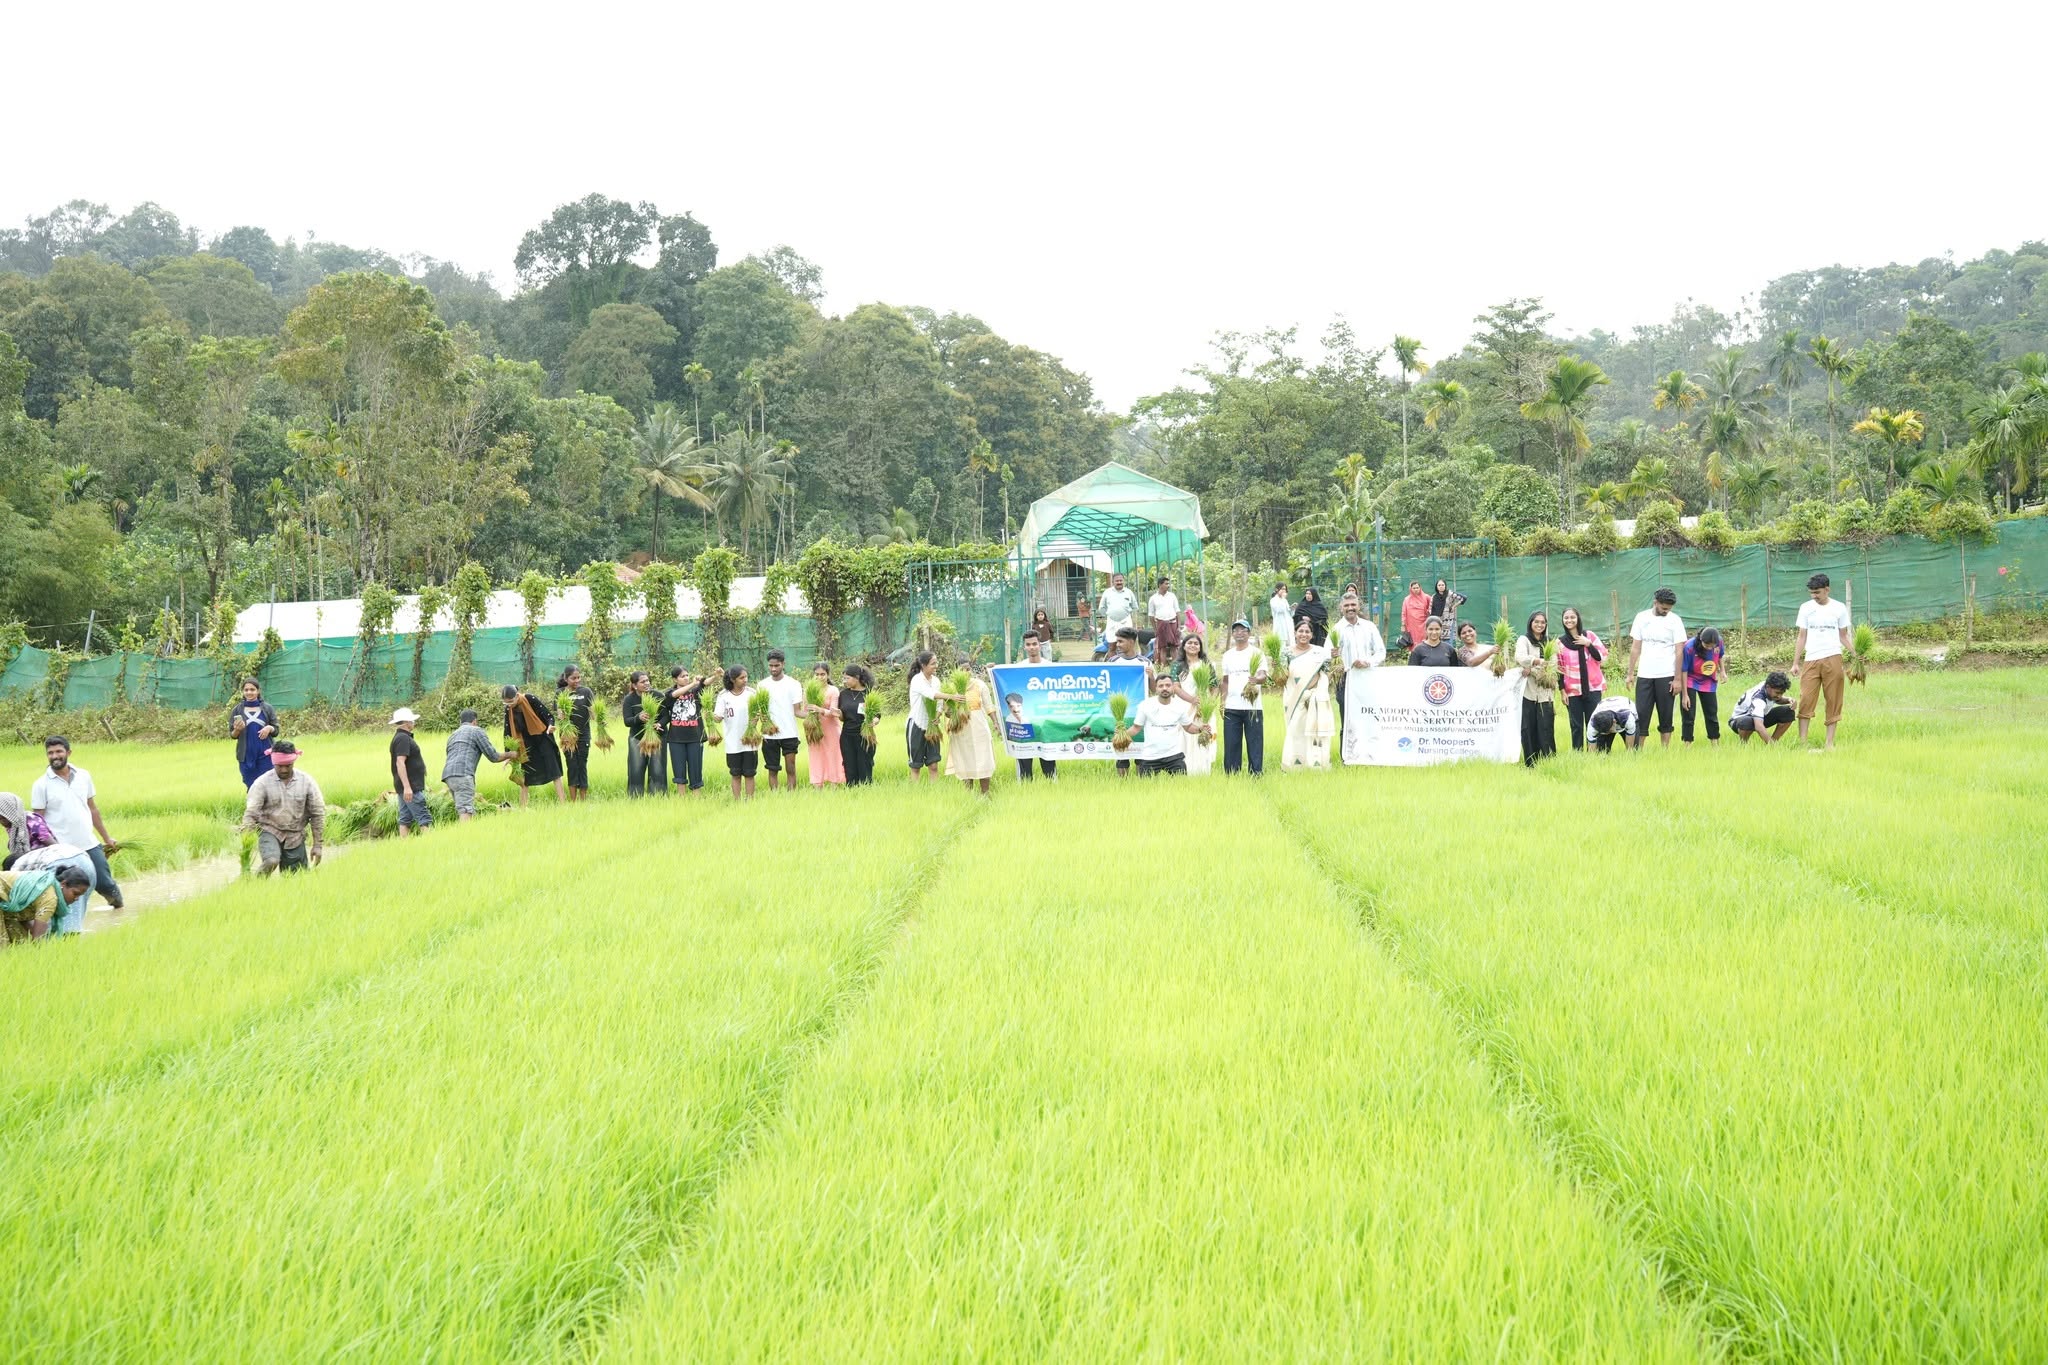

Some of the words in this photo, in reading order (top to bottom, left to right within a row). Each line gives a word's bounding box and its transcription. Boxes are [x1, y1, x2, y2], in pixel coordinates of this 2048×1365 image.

[1361, 706, 1377, 715] DR.
[1379, 707, 1427, 716] MOOPEN'S
[1430, 708, 1472, 717] NURSING
[1374, 715, 1421, 724] NATIONAL
[1423, 715, 1464, 725] SERVICE
[1466, 715, 1501, 725] SCHEME
[1418, 737, 1431, 746] Dr.
[1432, 737, 1475, 747] Moopen's
[1417, 746, 1449, 755] Nursing
